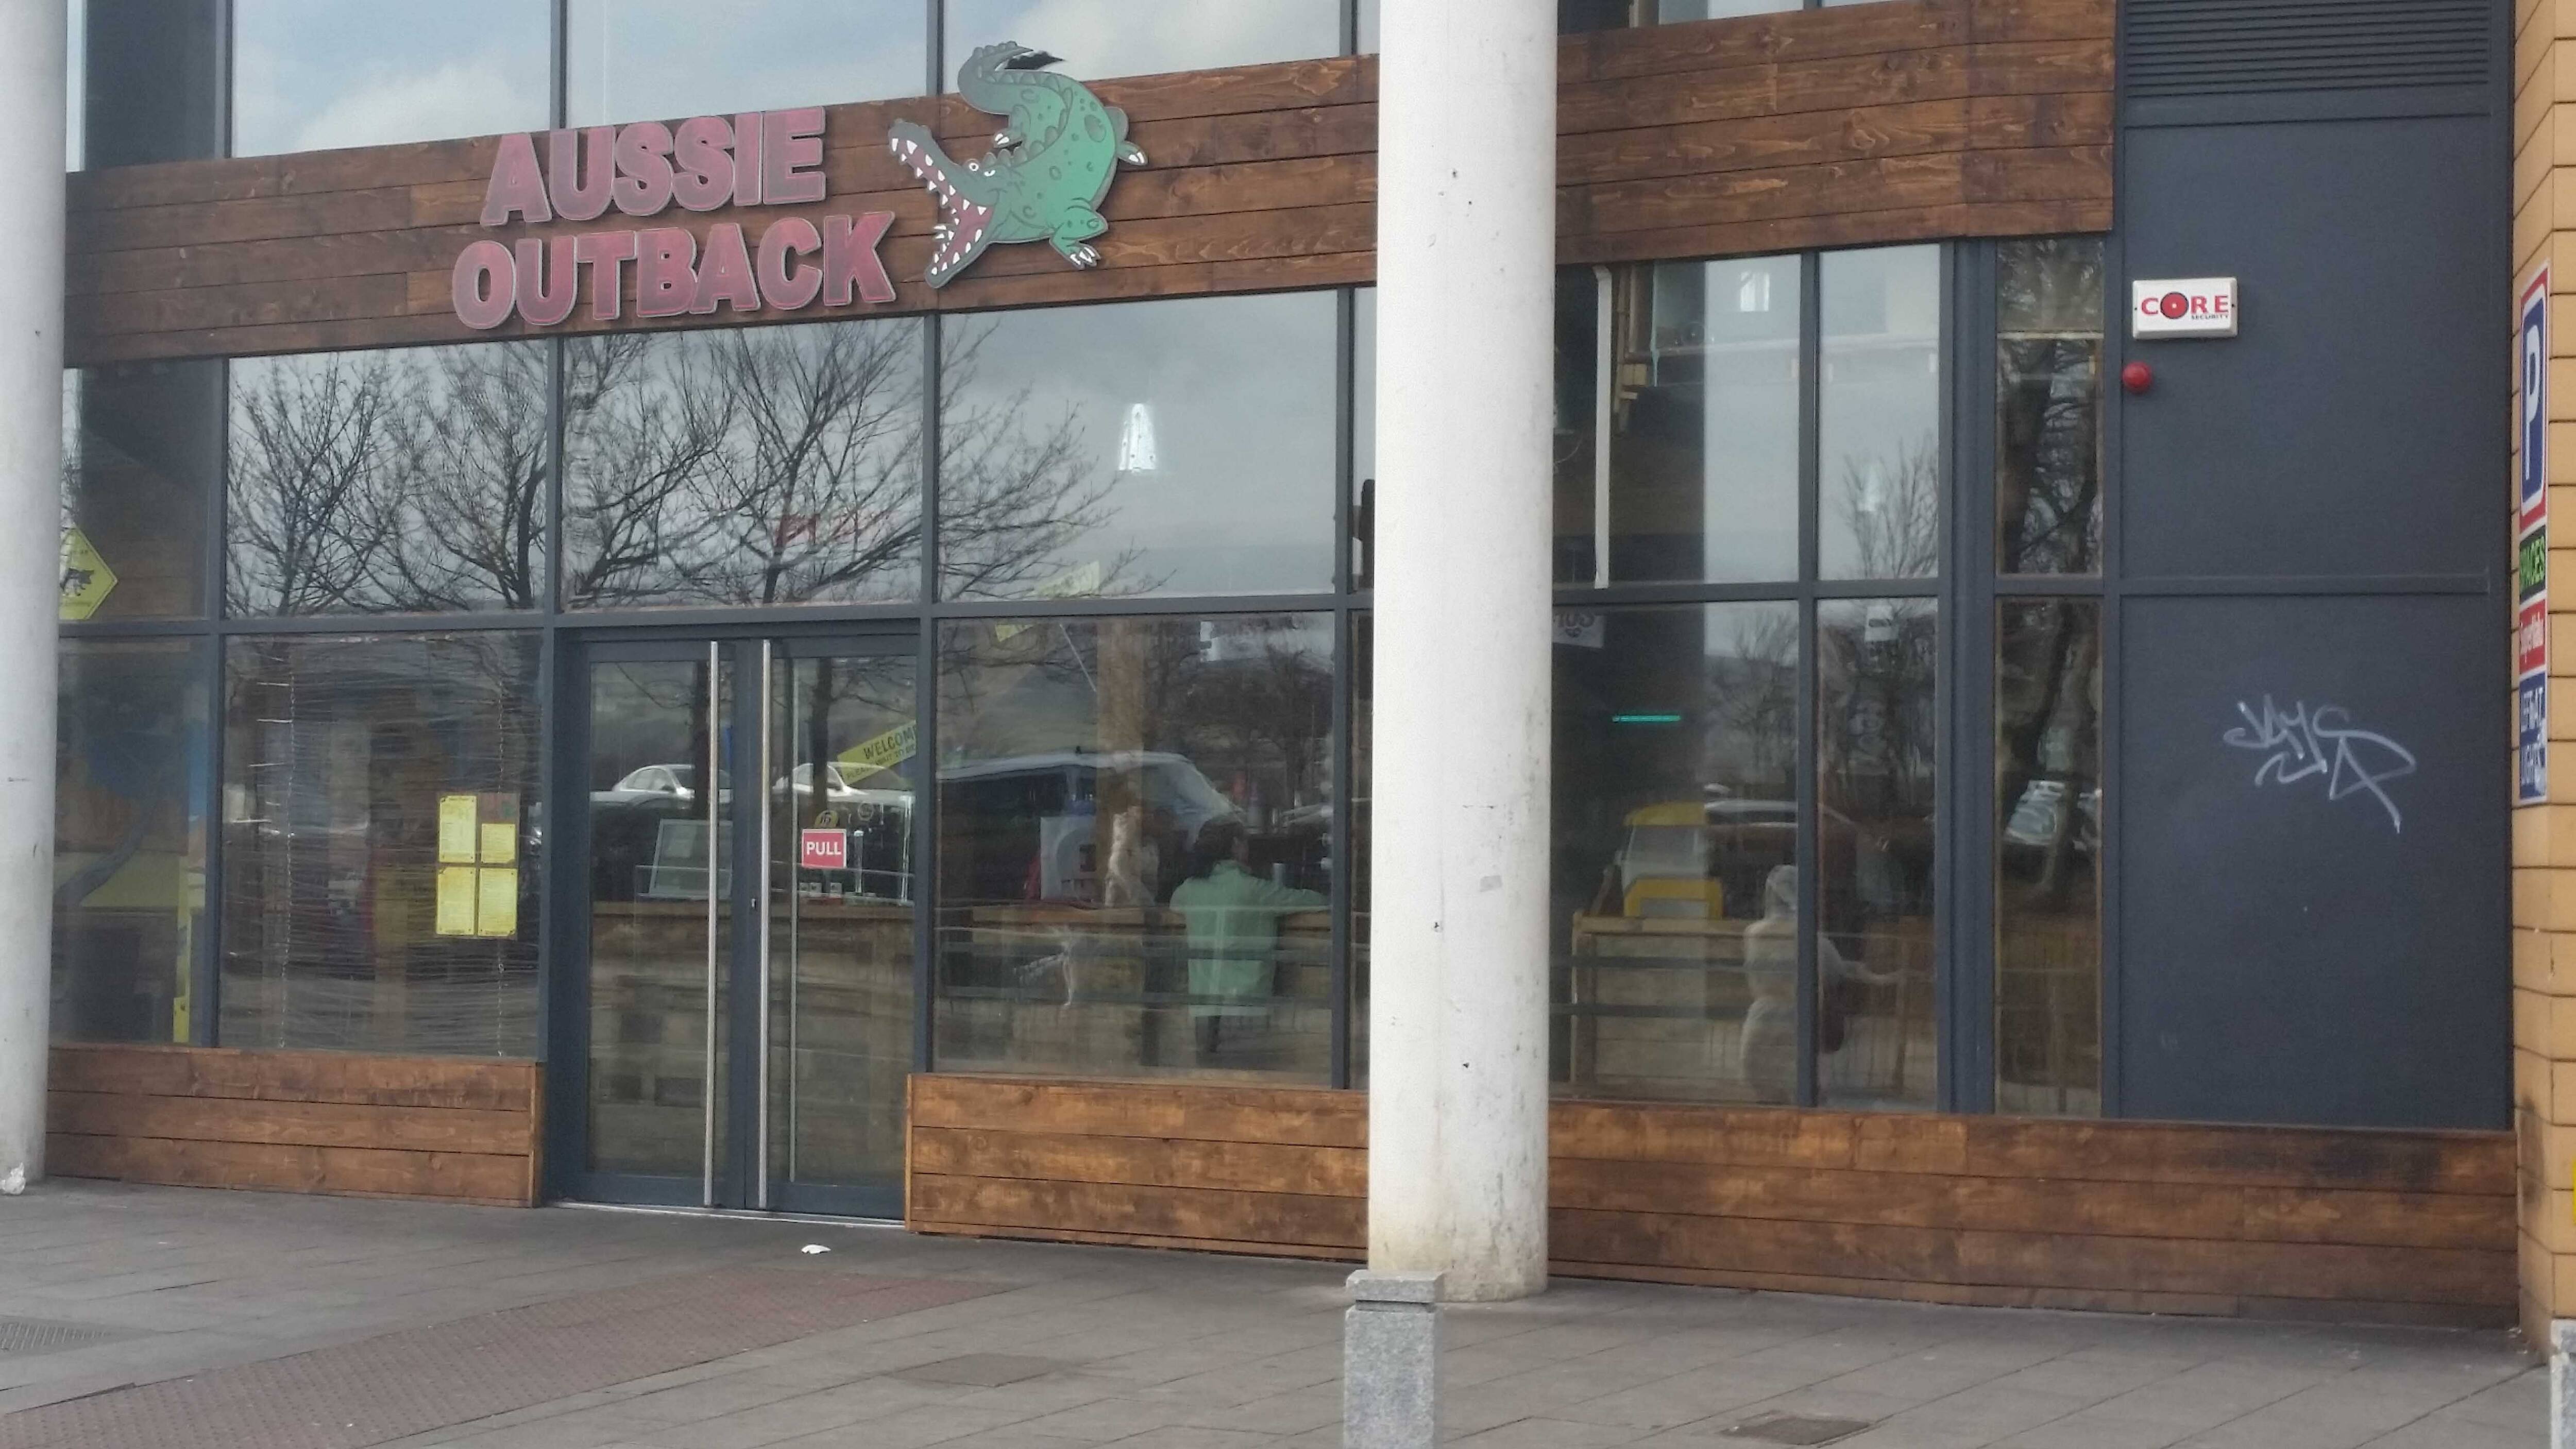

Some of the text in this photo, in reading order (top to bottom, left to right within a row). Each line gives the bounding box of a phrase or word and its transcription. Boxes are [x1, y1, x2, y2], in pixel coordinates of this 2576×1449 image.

[480, 106, 826, 227] AUSSIE
[452, 211, 896, 330] OUTBACK
[2141, 292, 2229, 319] CORE
[2525, 324, 2540, 481] P
[806, 842, 842, 856] PULL
